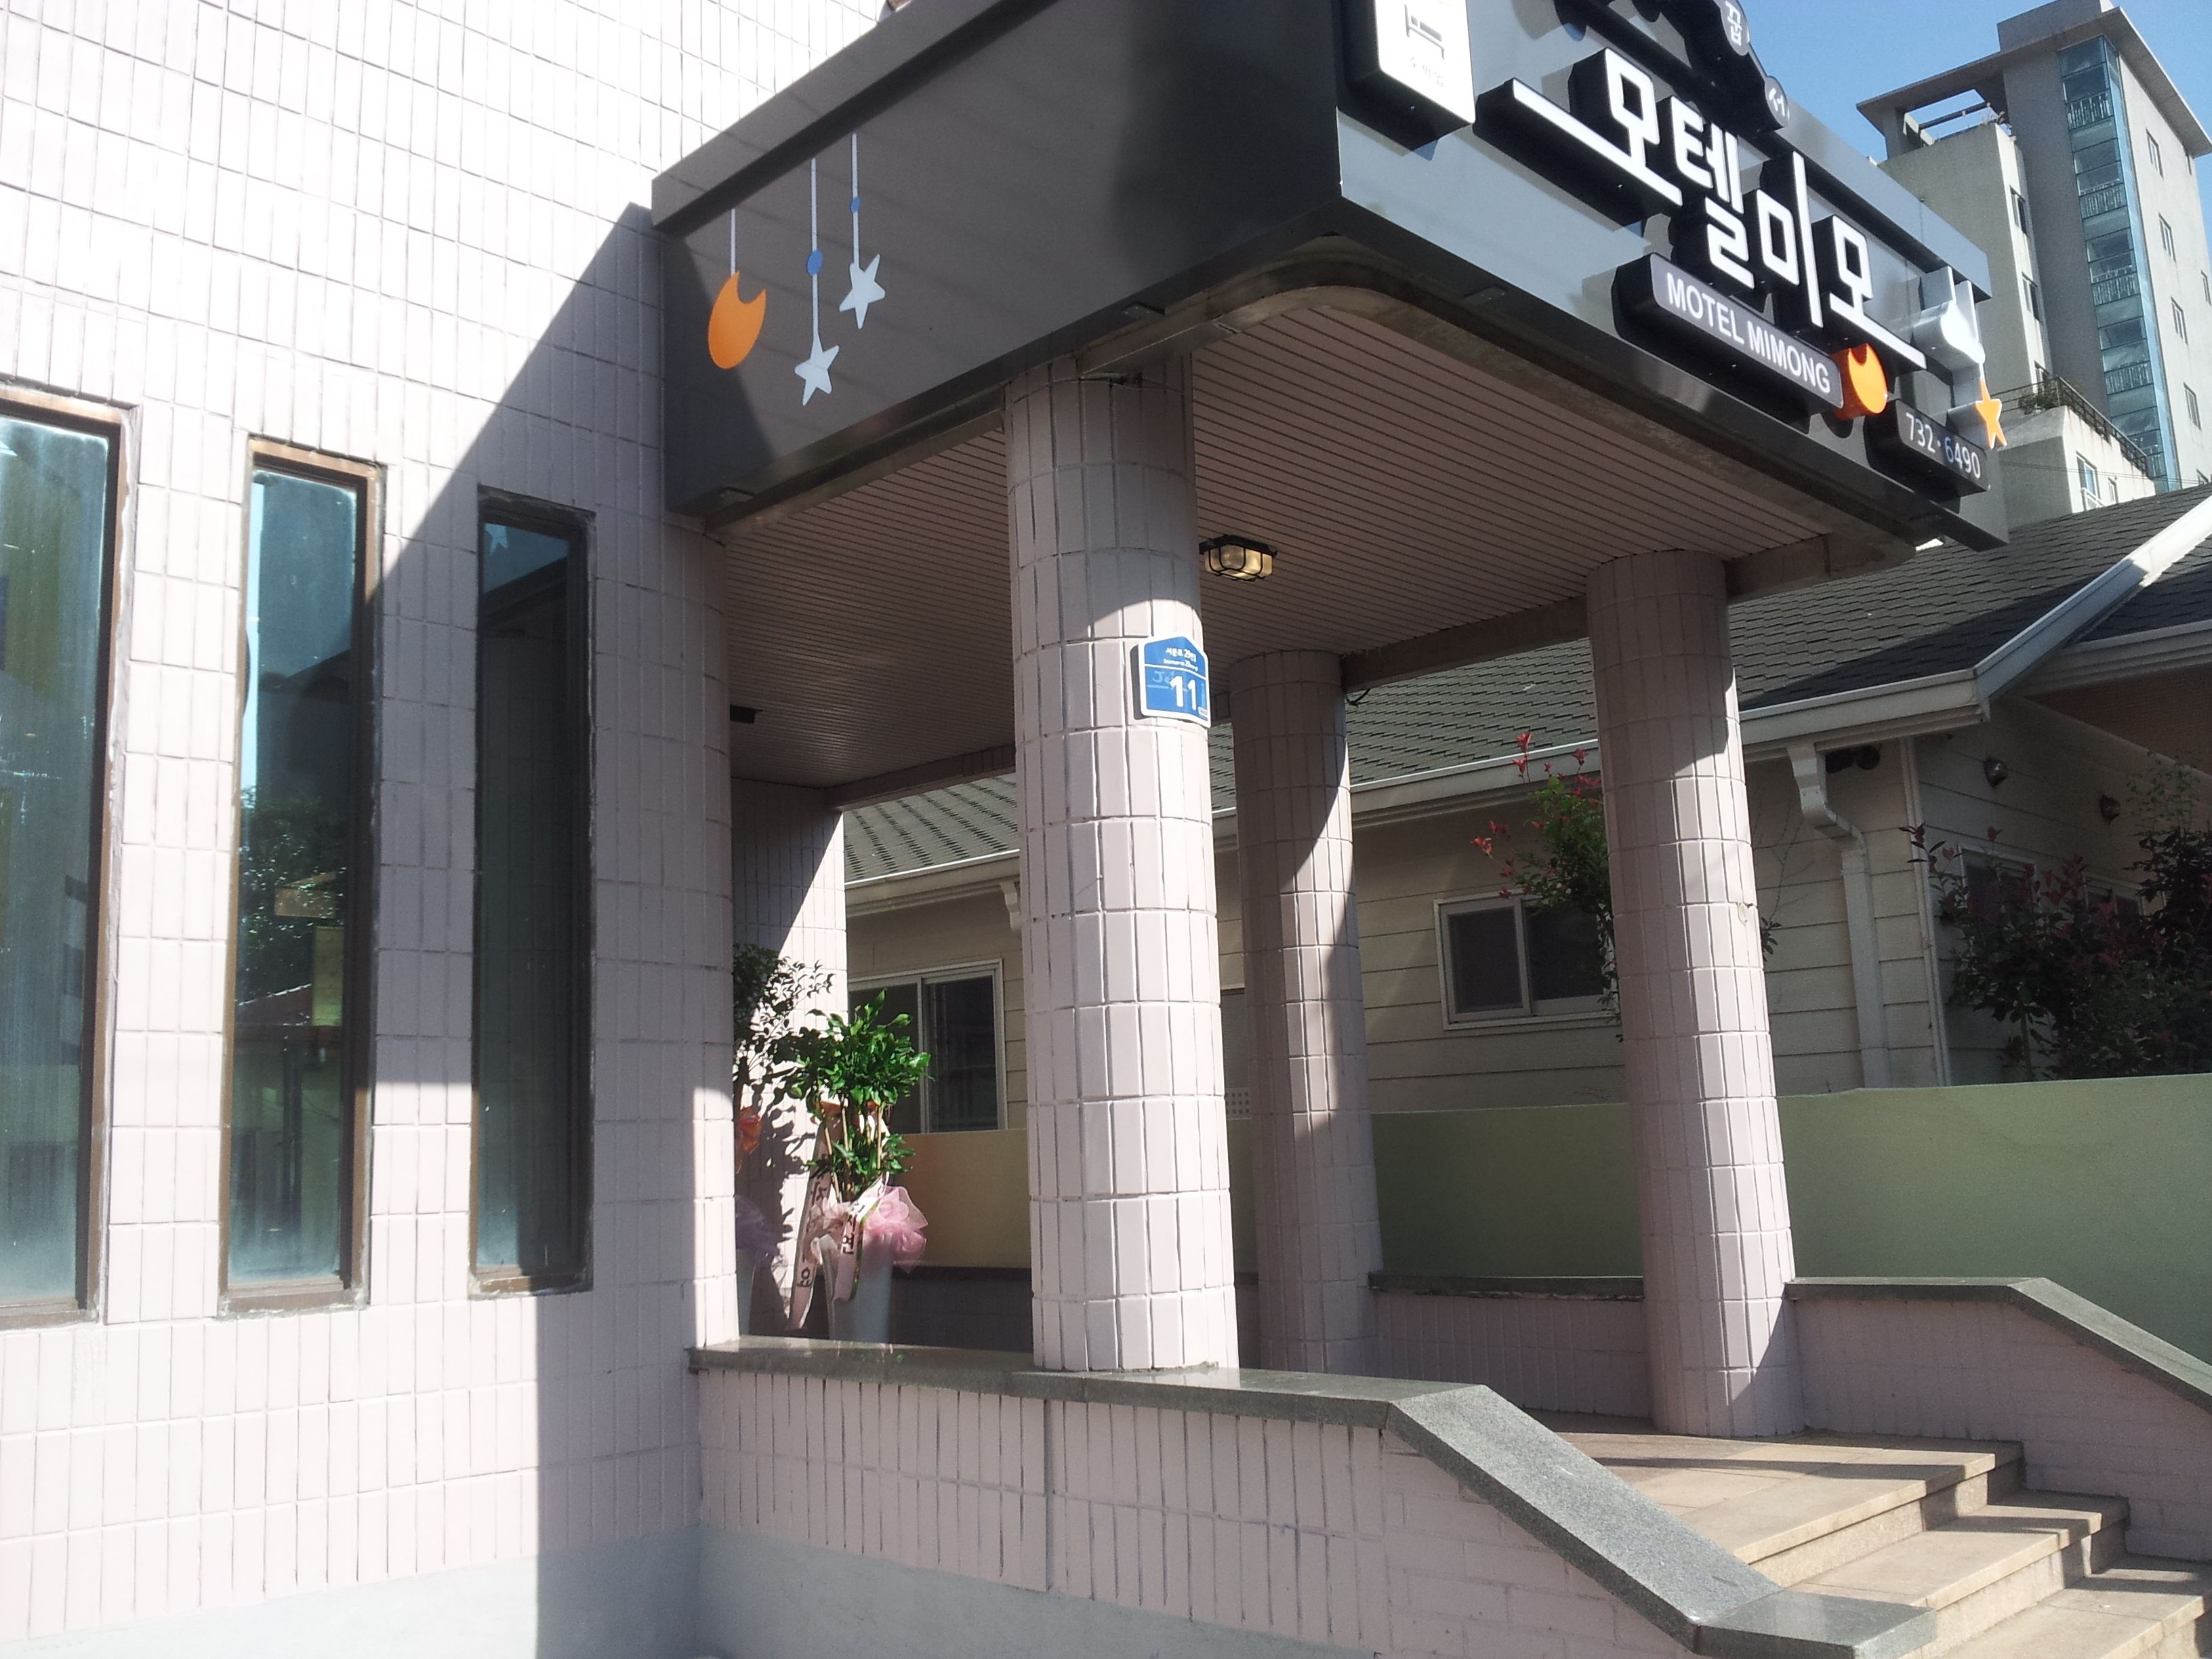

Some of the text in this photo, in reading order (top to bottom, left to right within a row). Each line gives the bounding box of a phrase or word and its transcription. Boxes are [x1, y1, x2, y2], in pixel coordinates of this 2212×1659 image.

[1666, 272, 1830, 394] MOTEL MIMONG
[1169, 675, 1197, 710] 11
